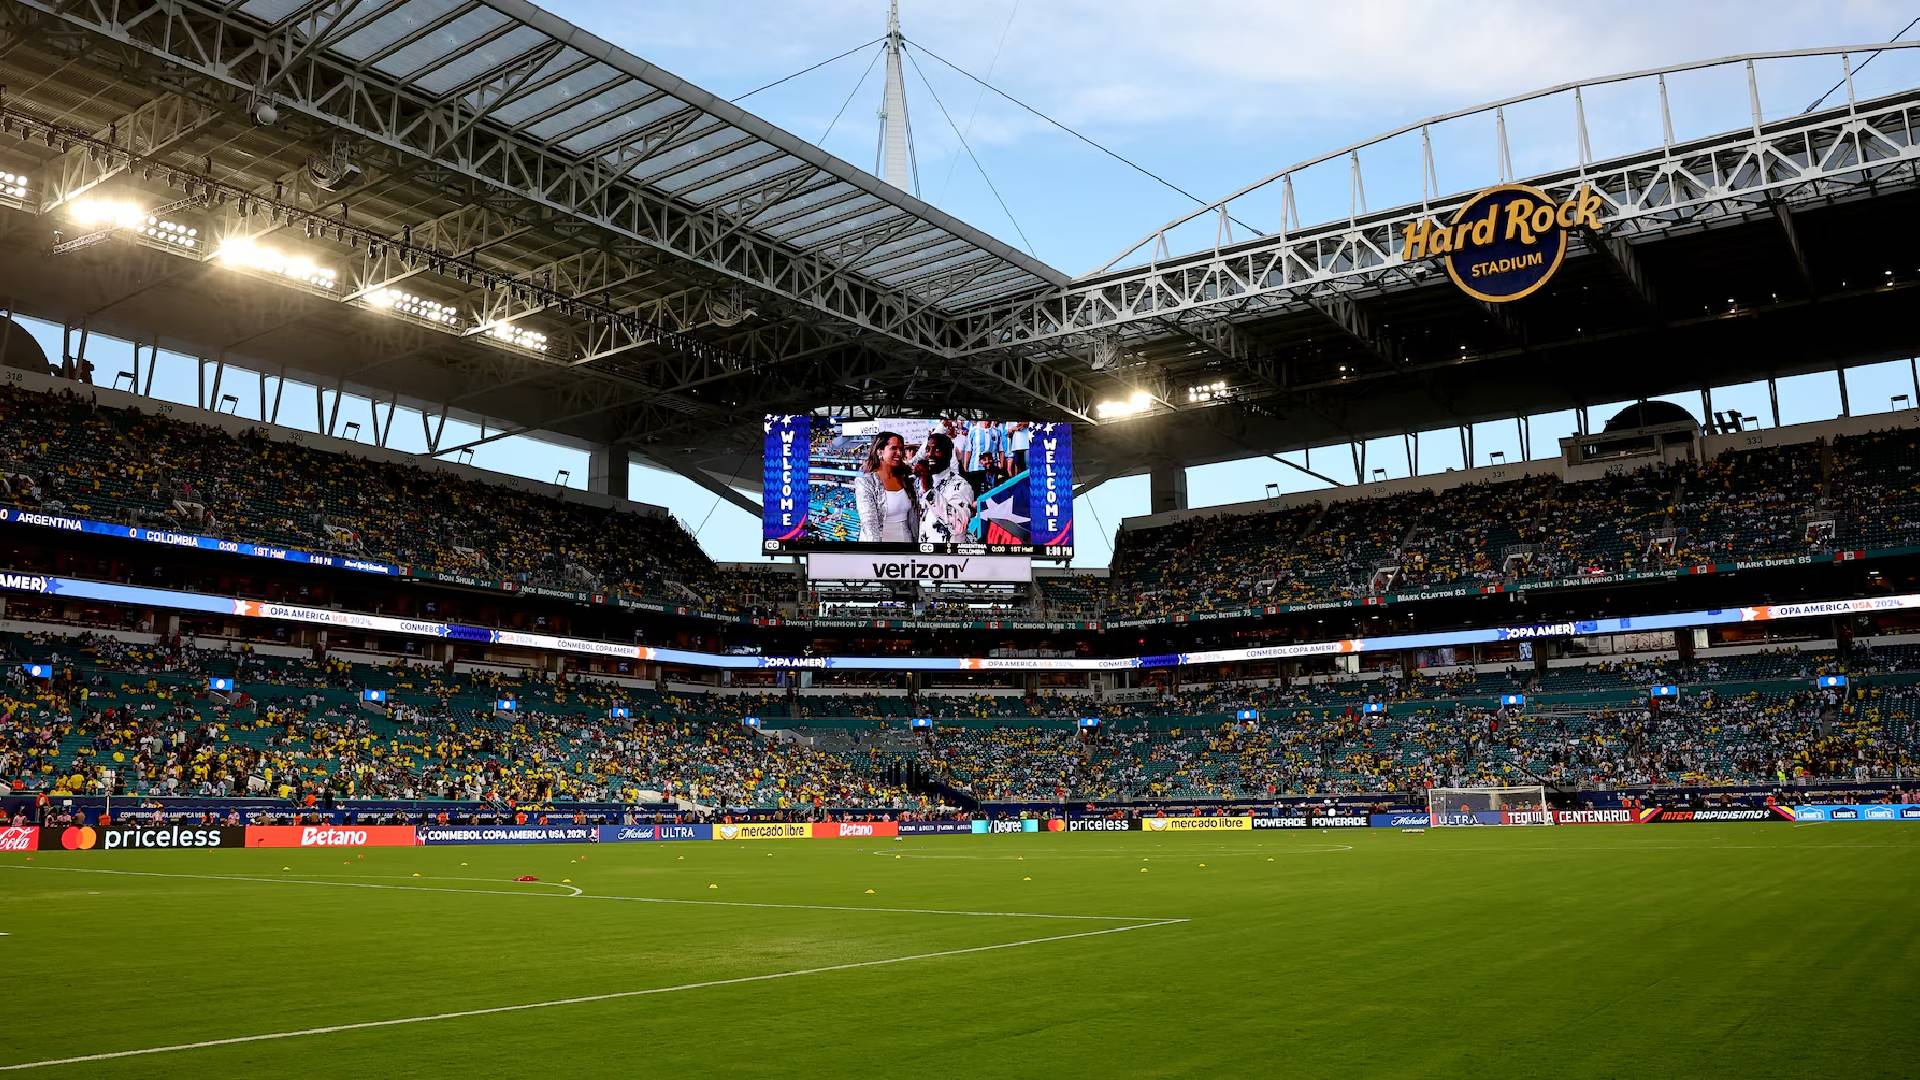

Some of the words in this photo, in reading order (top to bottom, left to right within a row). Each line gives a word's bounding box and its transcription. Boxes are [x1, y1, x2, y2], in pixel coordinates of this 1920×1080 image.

[1401, 204, 1499, 261] Hard
[1505, 184, 1603, 245] Rock
[1471, 252, 1544, 278] STADIUM
[5, 372, 23, 382] 318
[158, 404, 173, 413] 319
[780, 430, 794, 526] WELCOME
[1043, 438, 1059, 532] WELCOME
[0, 508, 8, 520] 0
[17, 513, 82, 531] ARGENTINA
[129, 528, 137, 538] 0
[146, 530, 199, 547] COLOMBIA
[219, 541, 238, 552] 0:00
[254, 547, 269, 557] 1ST
[1737, 561, 1763, 569] MARK
[1765, 558, 1795, 567] DUPER
[1798, 556, 1811, 564] 85
[872, 560, 958, 579] verizon
[1563, 579, 1580, 587] DAN
[578, 592, 587, 601] 85
[1397, 594, 1419, 602] MARK
[1420, 591, 1453, 600] CLAYTON
[1455, 588, 1466, 596] 83
[270, 607, 289, 617] OPA
[291, 609, 331, 622] AMERICA
[1780, 607, 1801, 616] OPA
[1803, 602, 1850, 613] AMERICA
[1852, 601, 1872, 609] USA
[1511, 627, 1535, 638] OPA
[557, 639, 594, 651] CONMEBOL
[768, 658, 791, 668] OPA
[988, 660, 1003, 668] OPA
[1004, 660, 1037, 668] AMERICA
[1171, 818, 1216, 829] mercado
[1217, 817, 1244, 828] libre
[1253, 816, 1307, 827] POWERADE
[1312, 815, 1368, 827] POWERADE
[1438, 815, 1479, 824] ULTRA
[1507, 811, 1554, 824] TEQUILA
[1559, 810, 1630, 823] CENTENARIO
[741, 823, 783, 838] mercado
[784, 822, 804, 837] libre
[840, 823, 872, 836] Betano
[993, 820, 1022, 834] Degree
[1070, 818, 1129, 832] priceless
[105, 826, 221, 849] priceless
[301, 828, 367, 846] Betano
[428, 830, 482, 841] CONMEBOL
[483, 830, 508, 840] COPA
[508, 829, 547, 840] AMERICA
[548, 829, 566, 839] USA
[566, 829, 586, 839] 2024
[661, 827, 695, 838] ULTRA
